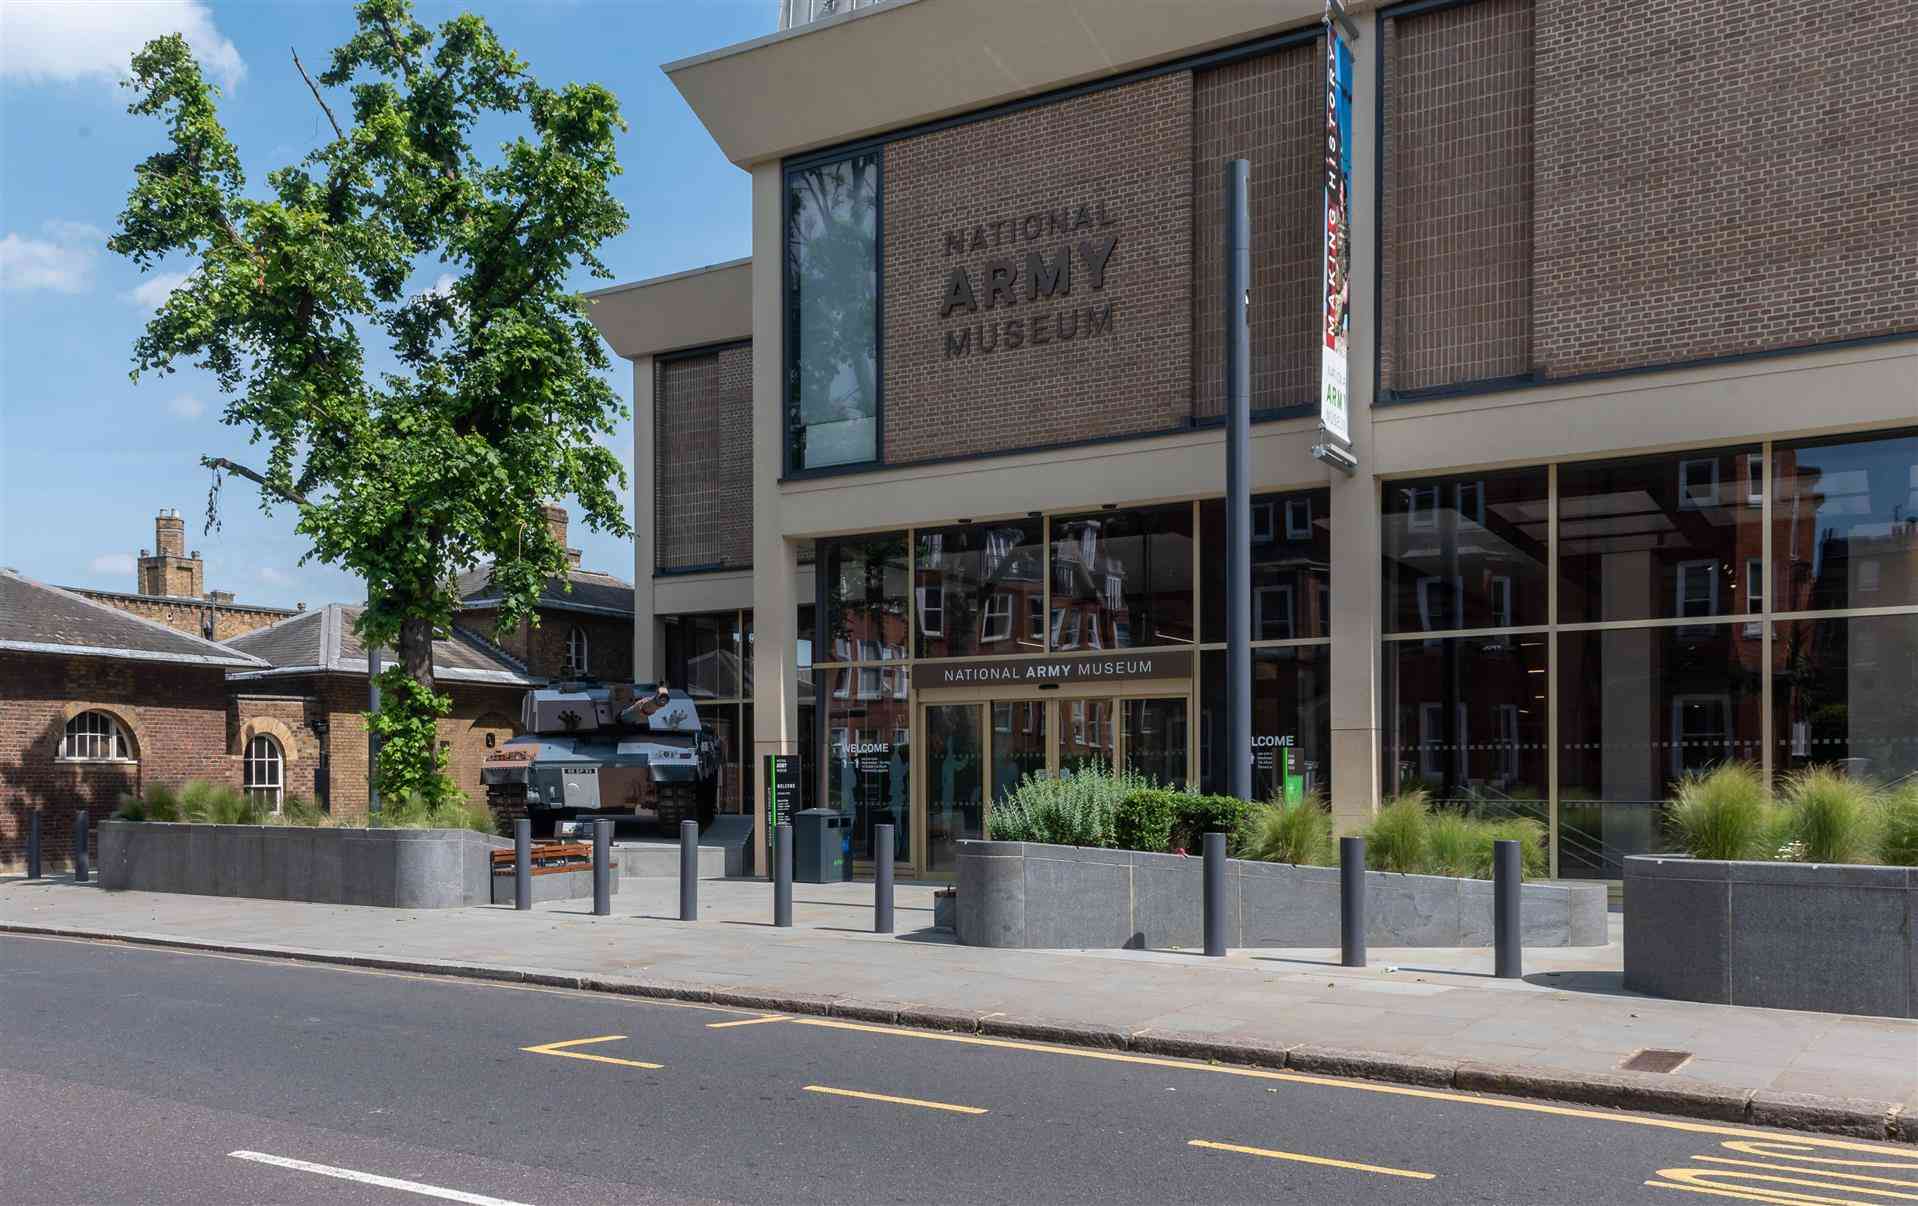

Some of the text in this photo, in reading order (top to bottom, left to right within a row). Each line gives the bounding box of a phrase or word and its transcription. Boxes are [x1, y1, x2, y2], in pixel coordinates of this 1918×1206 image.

[1327, 46, 1337, 336] MAKING HISTORY
[945, 200, 1117, 257] NATIONAL
[941, 236, 1119, 317] ARMY
[943, 303, 1114, 358] MUSEUM
[1327, 384, 1345, 410] ARM
[944, 660, 1153, 681] NATIONAL ARMY MUSEUM
[842, 743, 889, 753] WELCOME
[1251, 735, 1295, 747] LCOME
